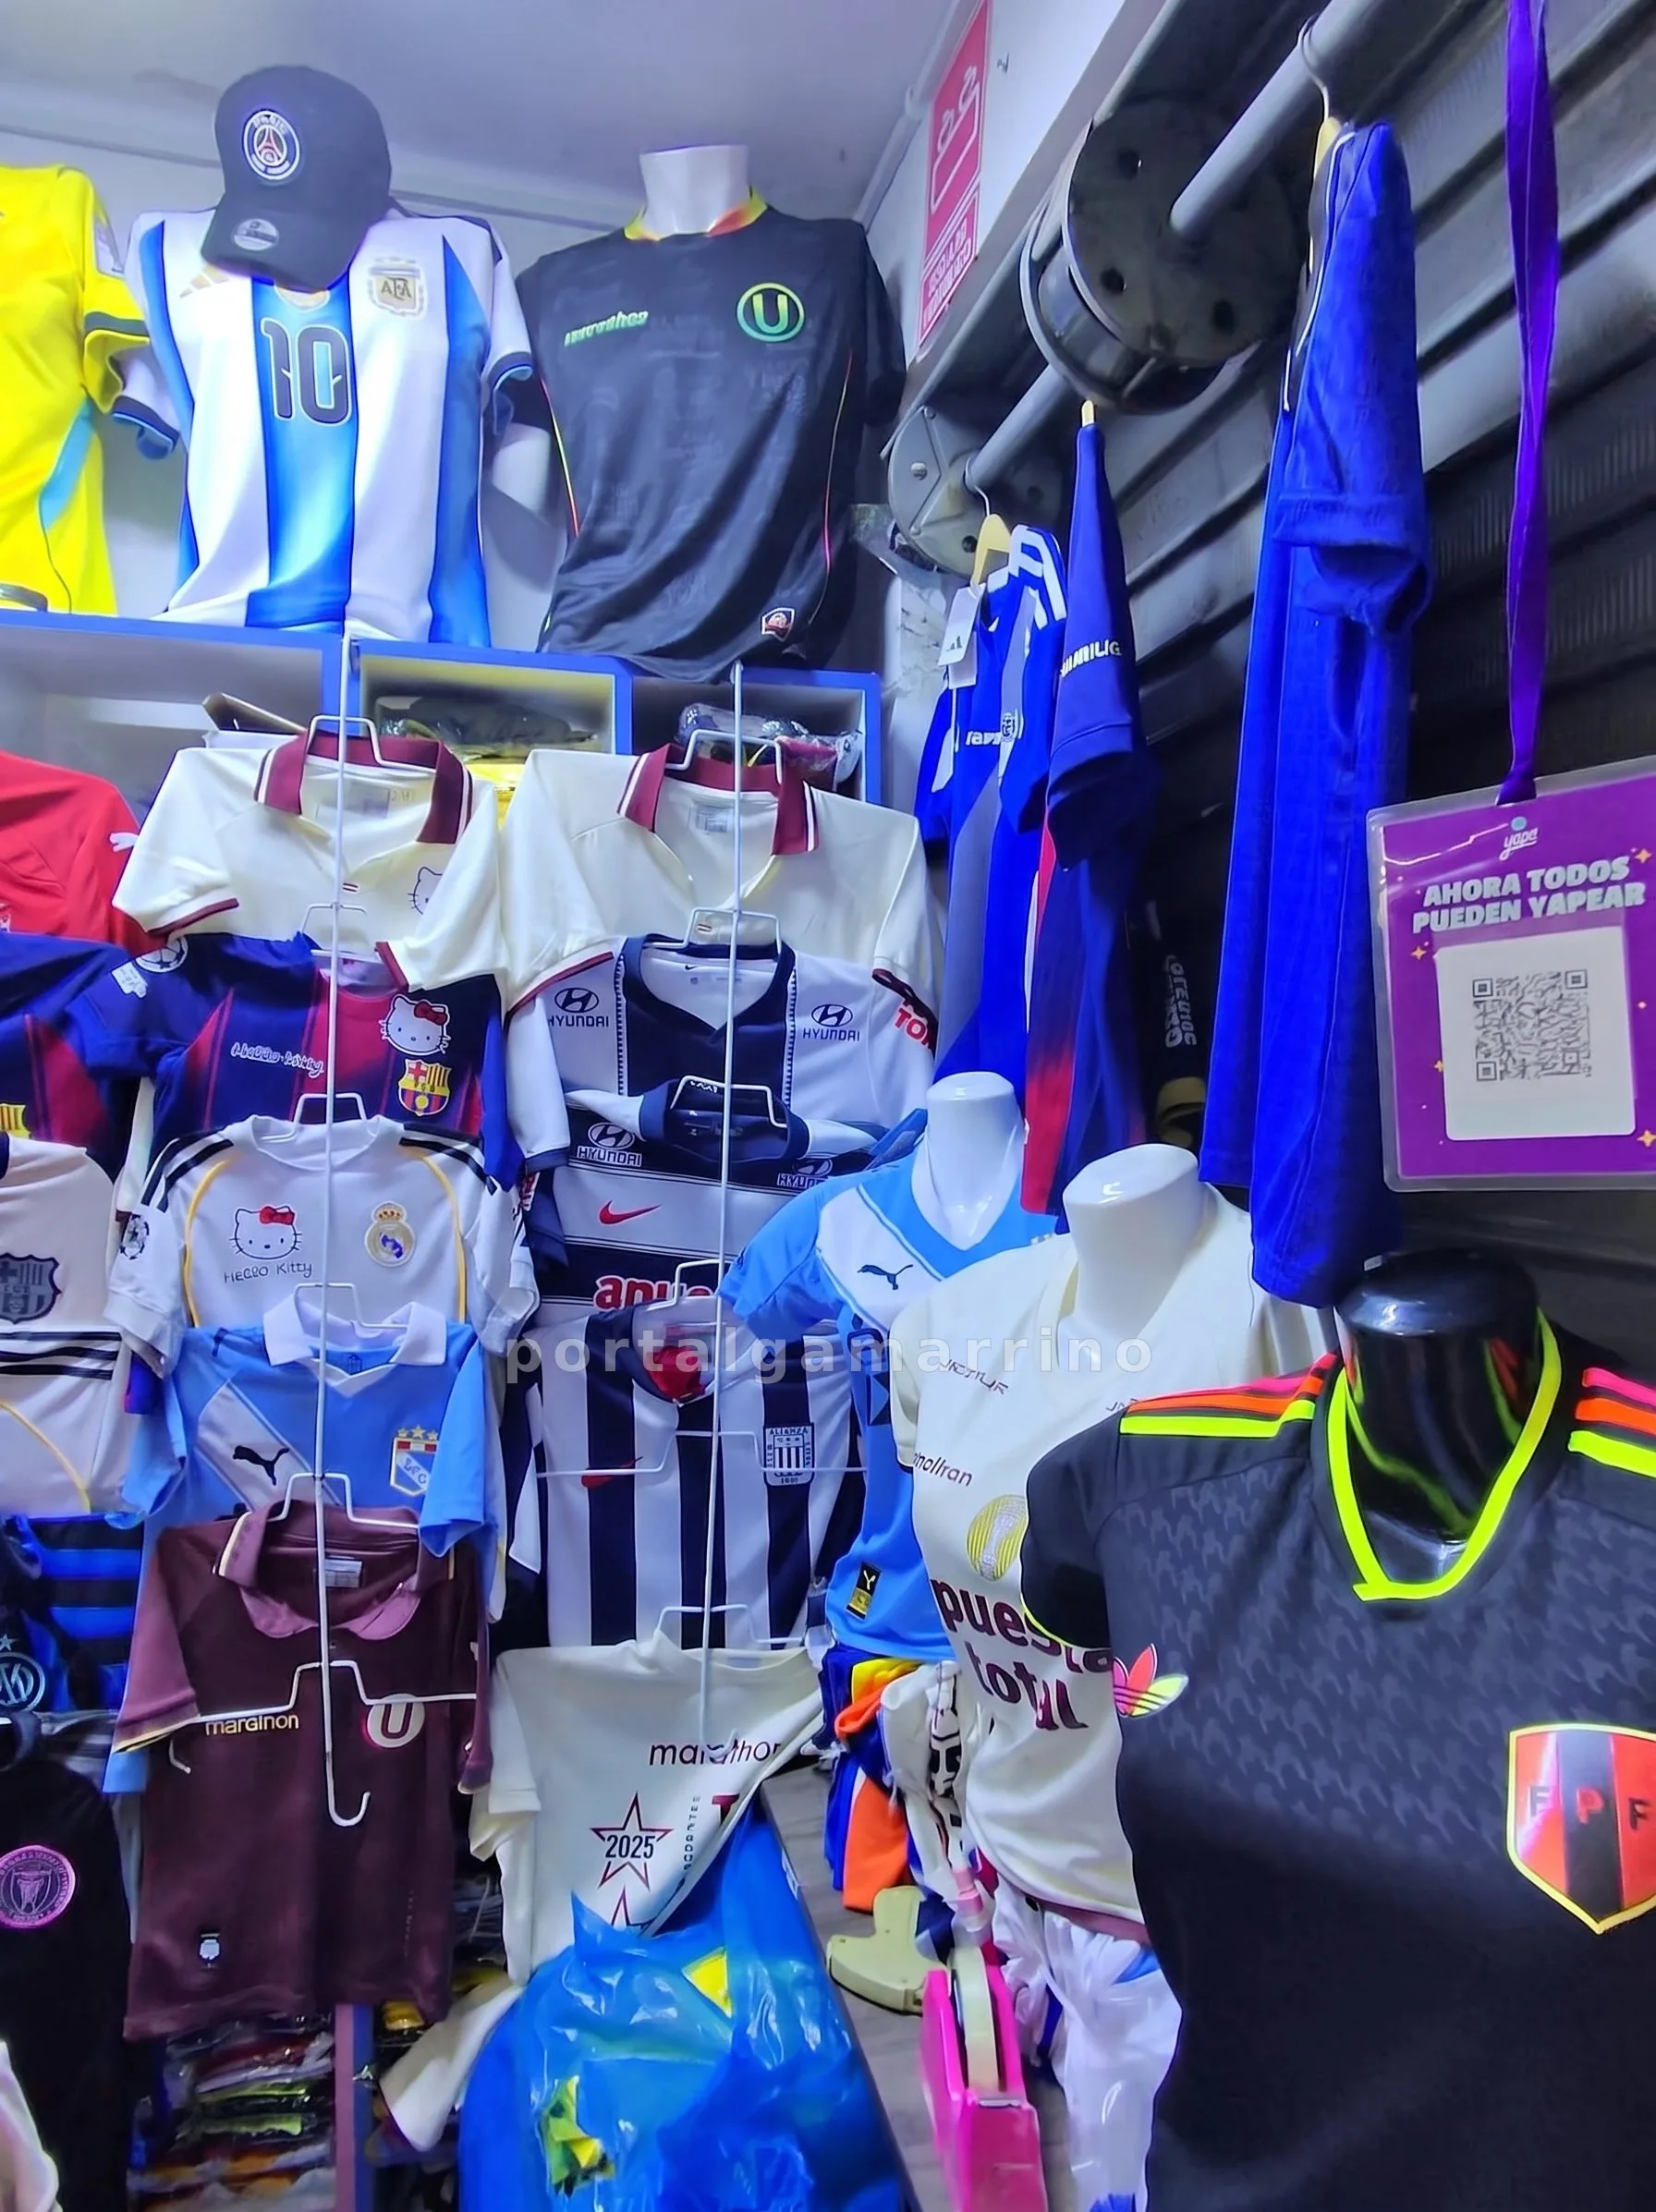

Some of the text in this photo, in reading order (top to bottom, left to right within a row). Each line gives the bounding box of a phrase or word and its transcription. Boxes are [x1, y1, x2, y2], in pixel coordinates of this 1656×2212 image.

[261, 317, 352, 426] 10
[1423, 856, 1630, 907] AHORA TODOS
[1412, 881, 1646, 934] PUEDEN YAPEAR
[803, 1027, 860, 1041] HYUNDAI
[577, 1146, 642, 1167] HYUNDAI
[605, 1834, 656, 1859] 2025
